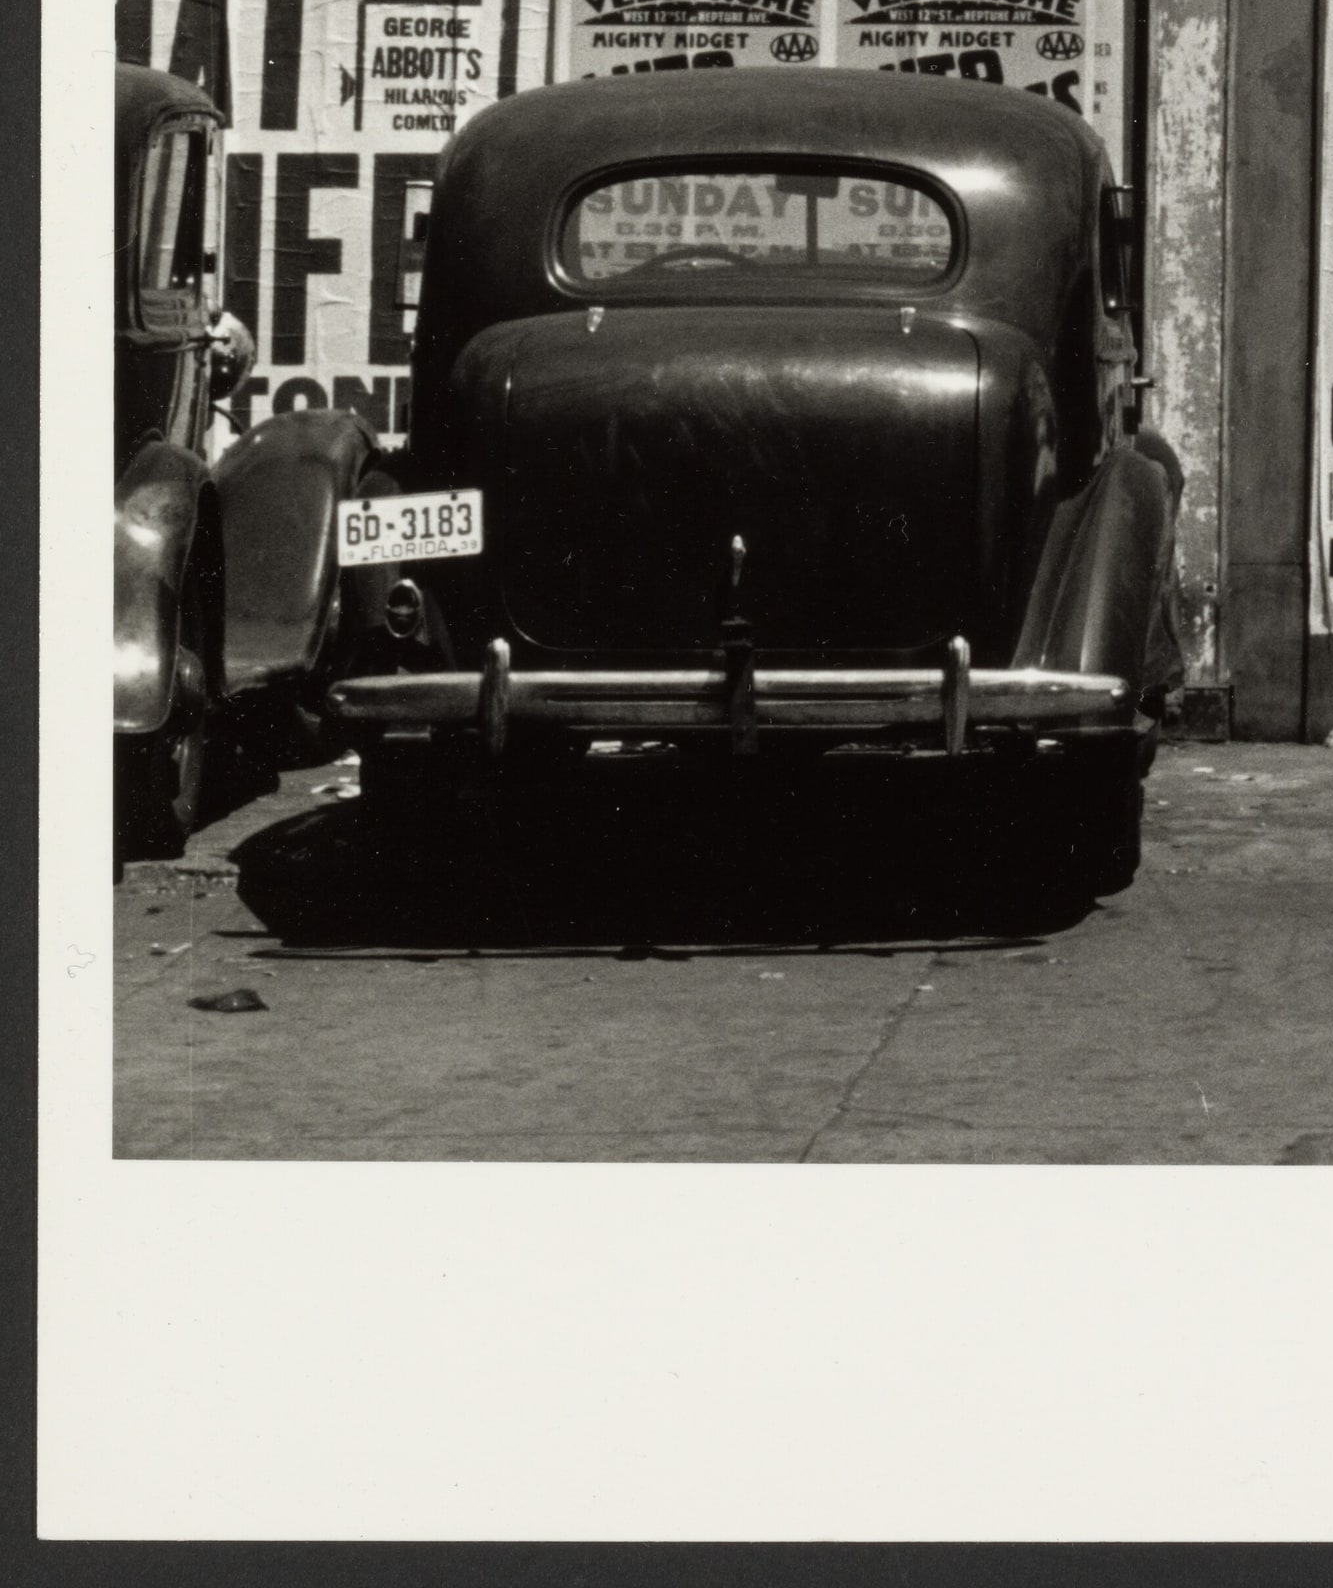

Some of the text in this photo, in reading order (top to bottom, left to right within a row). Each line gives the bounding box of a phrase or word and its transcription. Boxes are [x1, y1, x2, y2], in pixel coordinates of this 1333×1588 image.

[383, 17, 471, 38] GEORGE
[592, 32, 750, 49] MIGHTY MIDGET
[773, 33, 816, 62] AAA
[858, 30, 1016, 47] MIGHTY MIDGET
[1040, 31, 1083, 60] AAA
[383, 88, 468, 106] HILARIOUS
[345, 503, 473, 546] 6D-3183
[370, 539, 449, 559] FLORIDA
